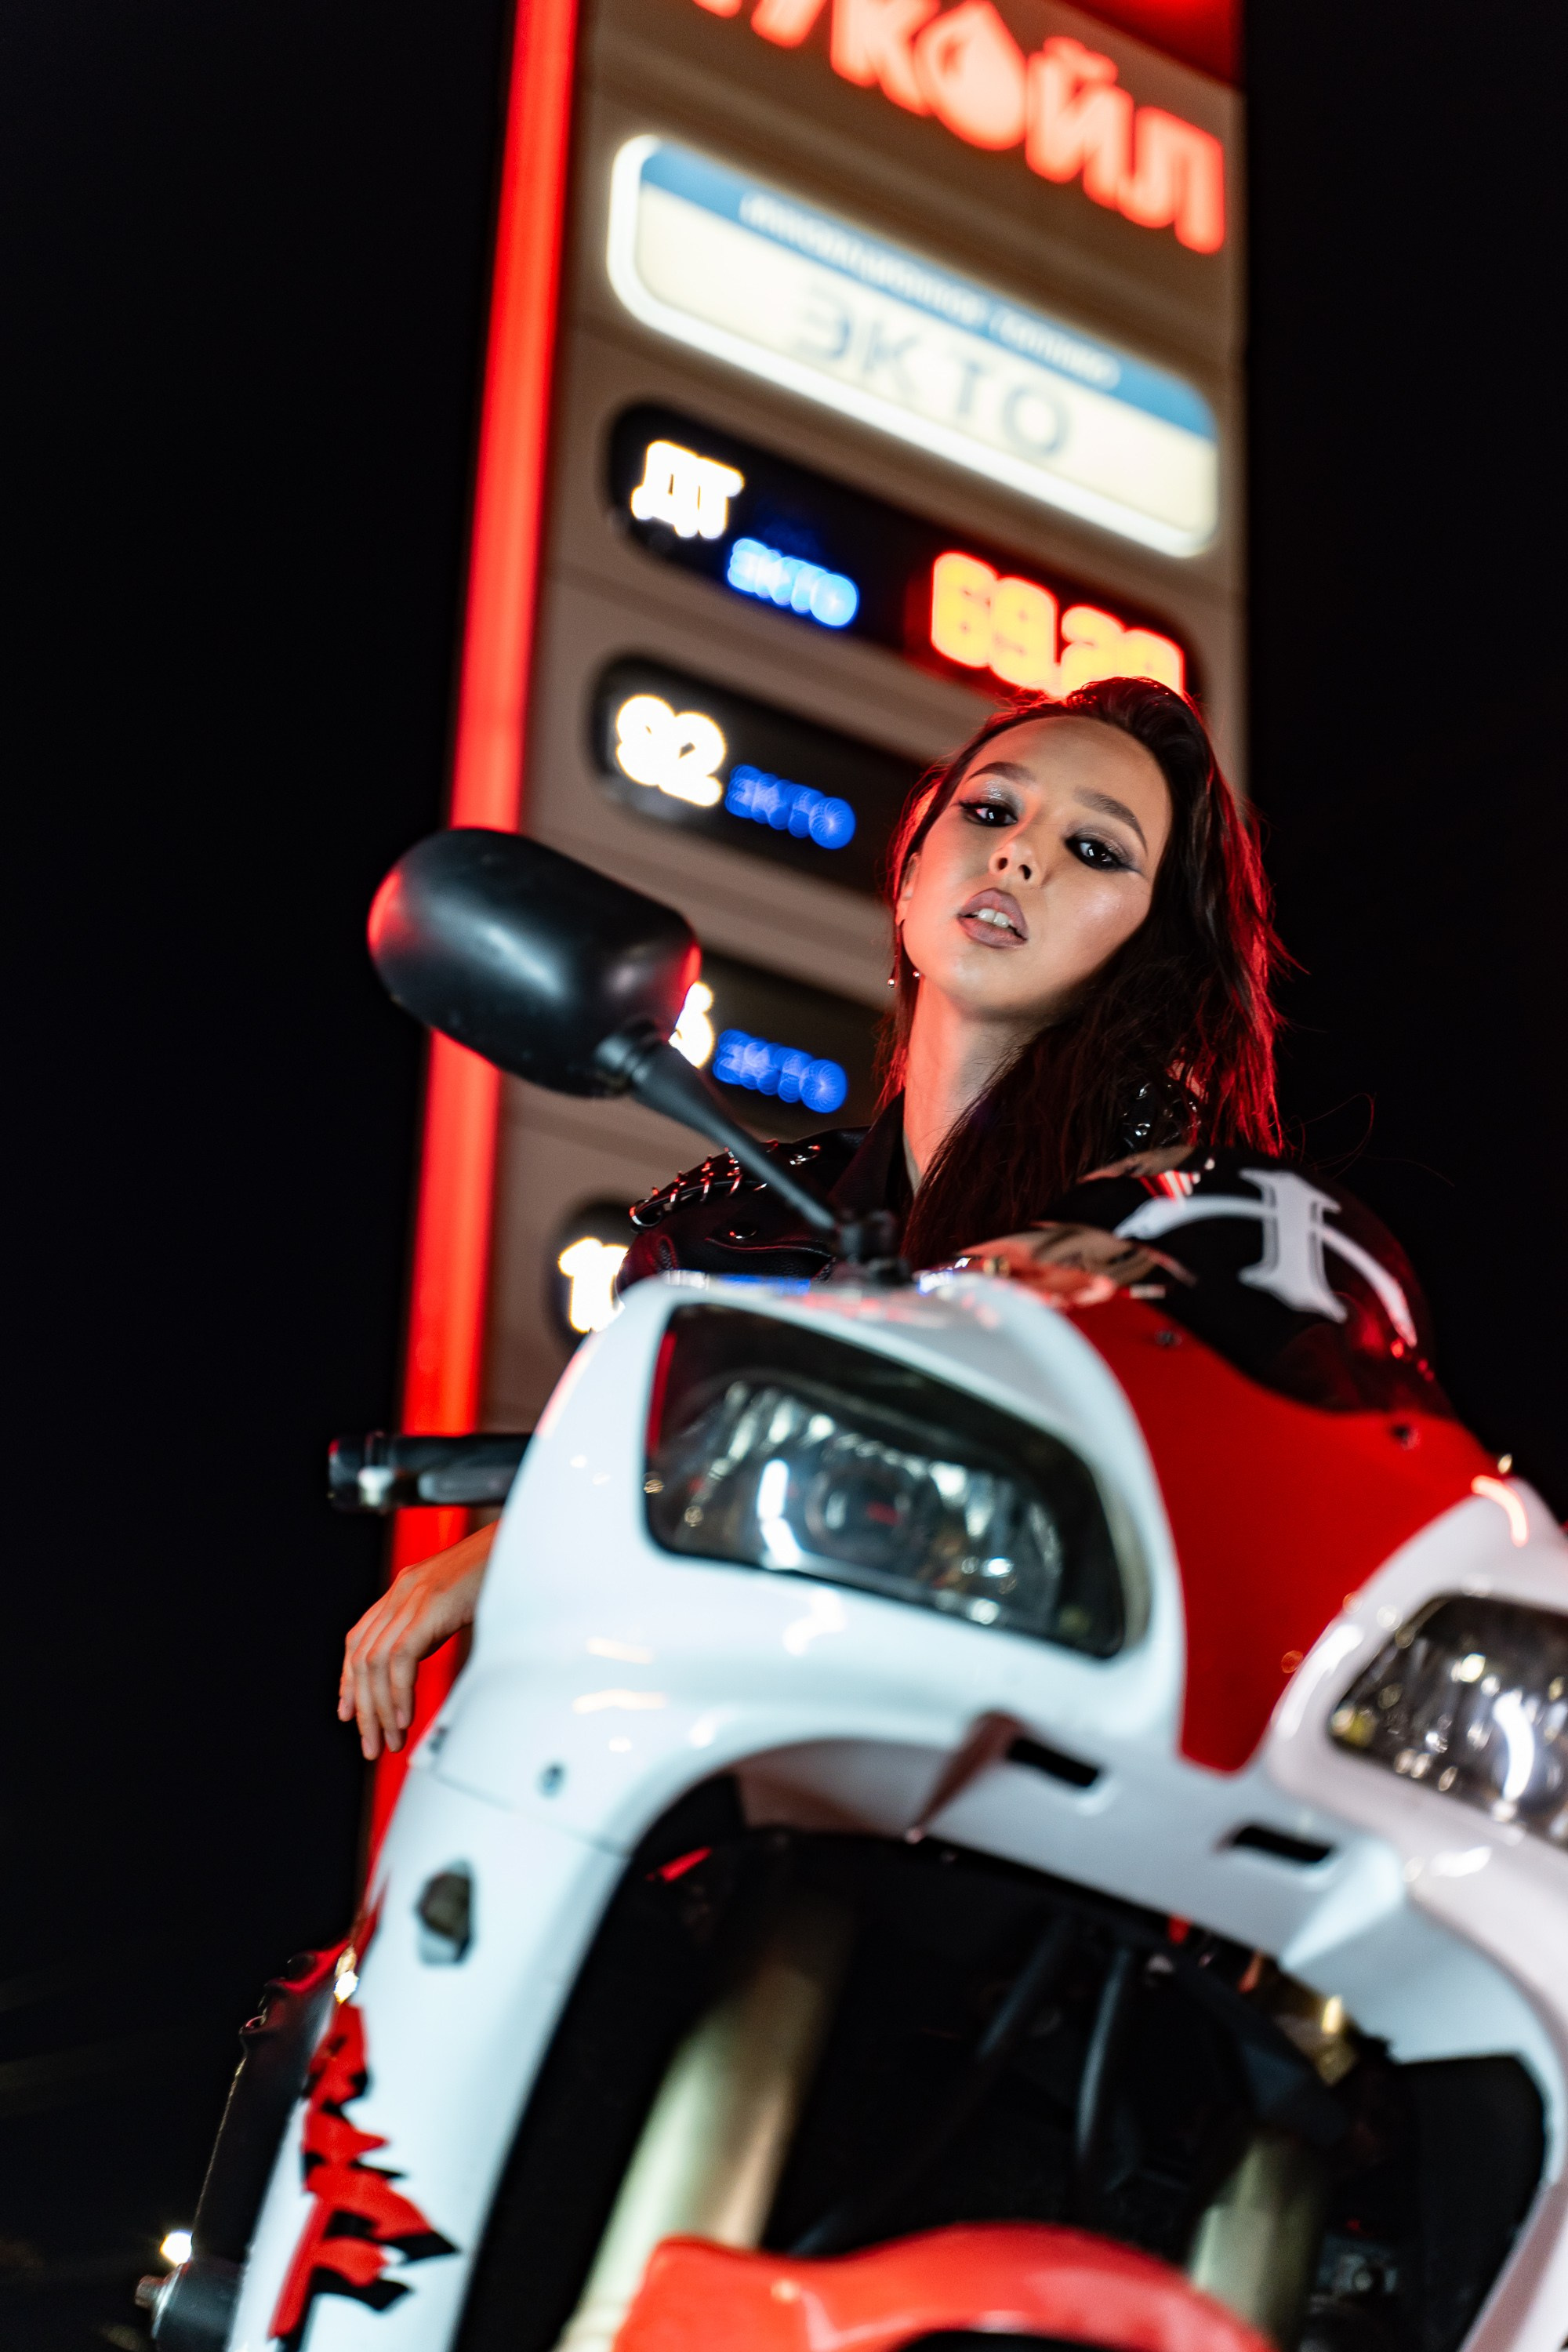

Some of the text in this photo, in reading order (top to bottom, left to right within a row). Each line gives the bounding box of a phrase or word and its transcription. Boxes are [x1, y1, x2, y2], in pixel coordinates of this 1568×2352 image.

[693, 0, 1225, 254] КОЙЛ
[789, 282, 1073, 459] ЭКТО
[631, 440, 744, 539] ДТ
[615, 694, 726, 807] 92
